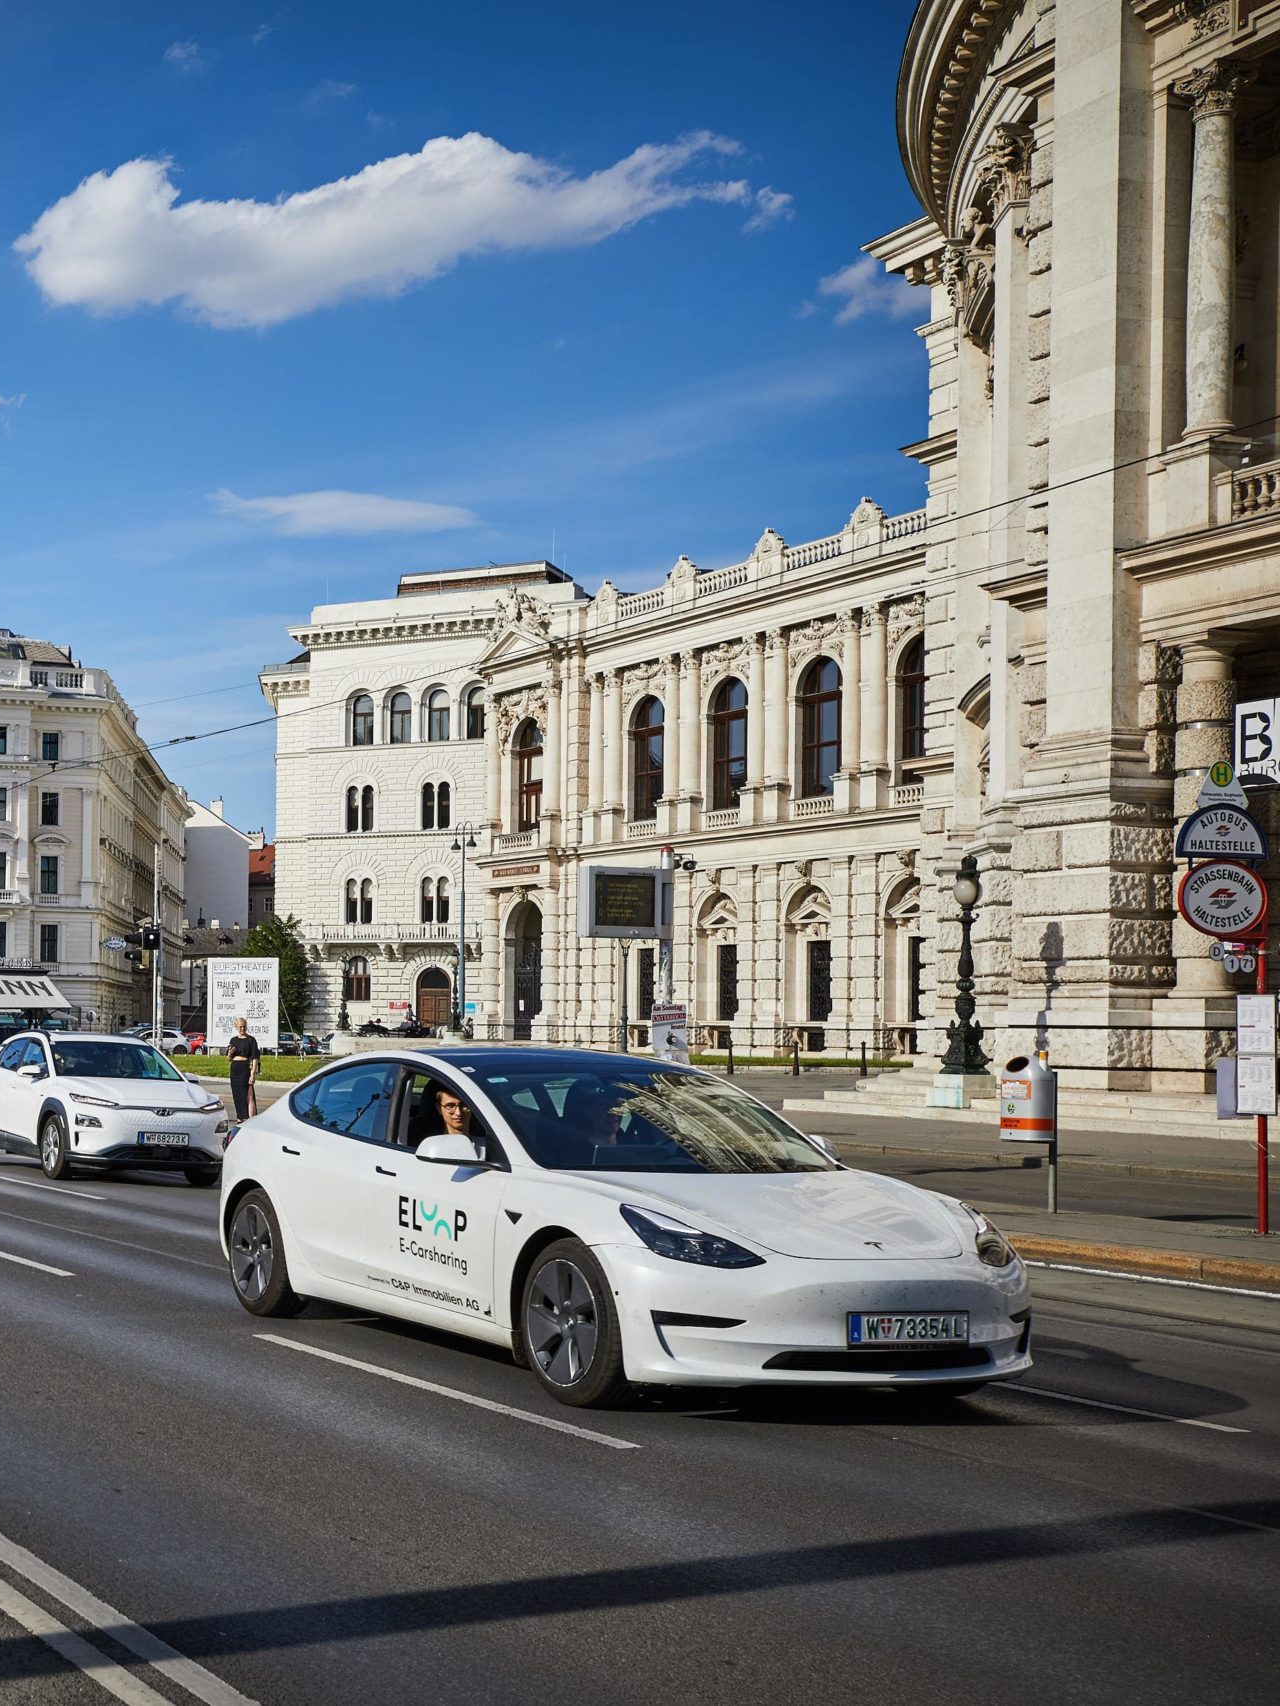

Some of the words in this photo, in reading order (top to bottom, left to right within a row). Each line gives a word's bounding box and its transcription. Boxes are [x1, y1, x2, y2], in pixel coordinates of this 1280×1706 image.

[1240, 711, 1273, 765] B
[1216, 766, 1228, 782] H
[1199, 811, 1248, 832] AUTOBUS
[1190, 839, 1256, 852] HALTESTELLE
[1190, 868, 1256, 896] STRASSENBAHN
[1192, 906, 1254, 928] HALTESTELLE
[1213, 946, 1221, 957] D
[213, 963, 273, 972] BURGTHEATER
[1229, 958, 1234, 969] 1
[1242, 958, 1254, 969] 71
[399, 1236, 468, 1276] E-Carsharing
[391, 1278, 411, 1292] C&P
[412, 1283, 464, 1307] Immobilien
[466, 1297, 480, 1311] AG
